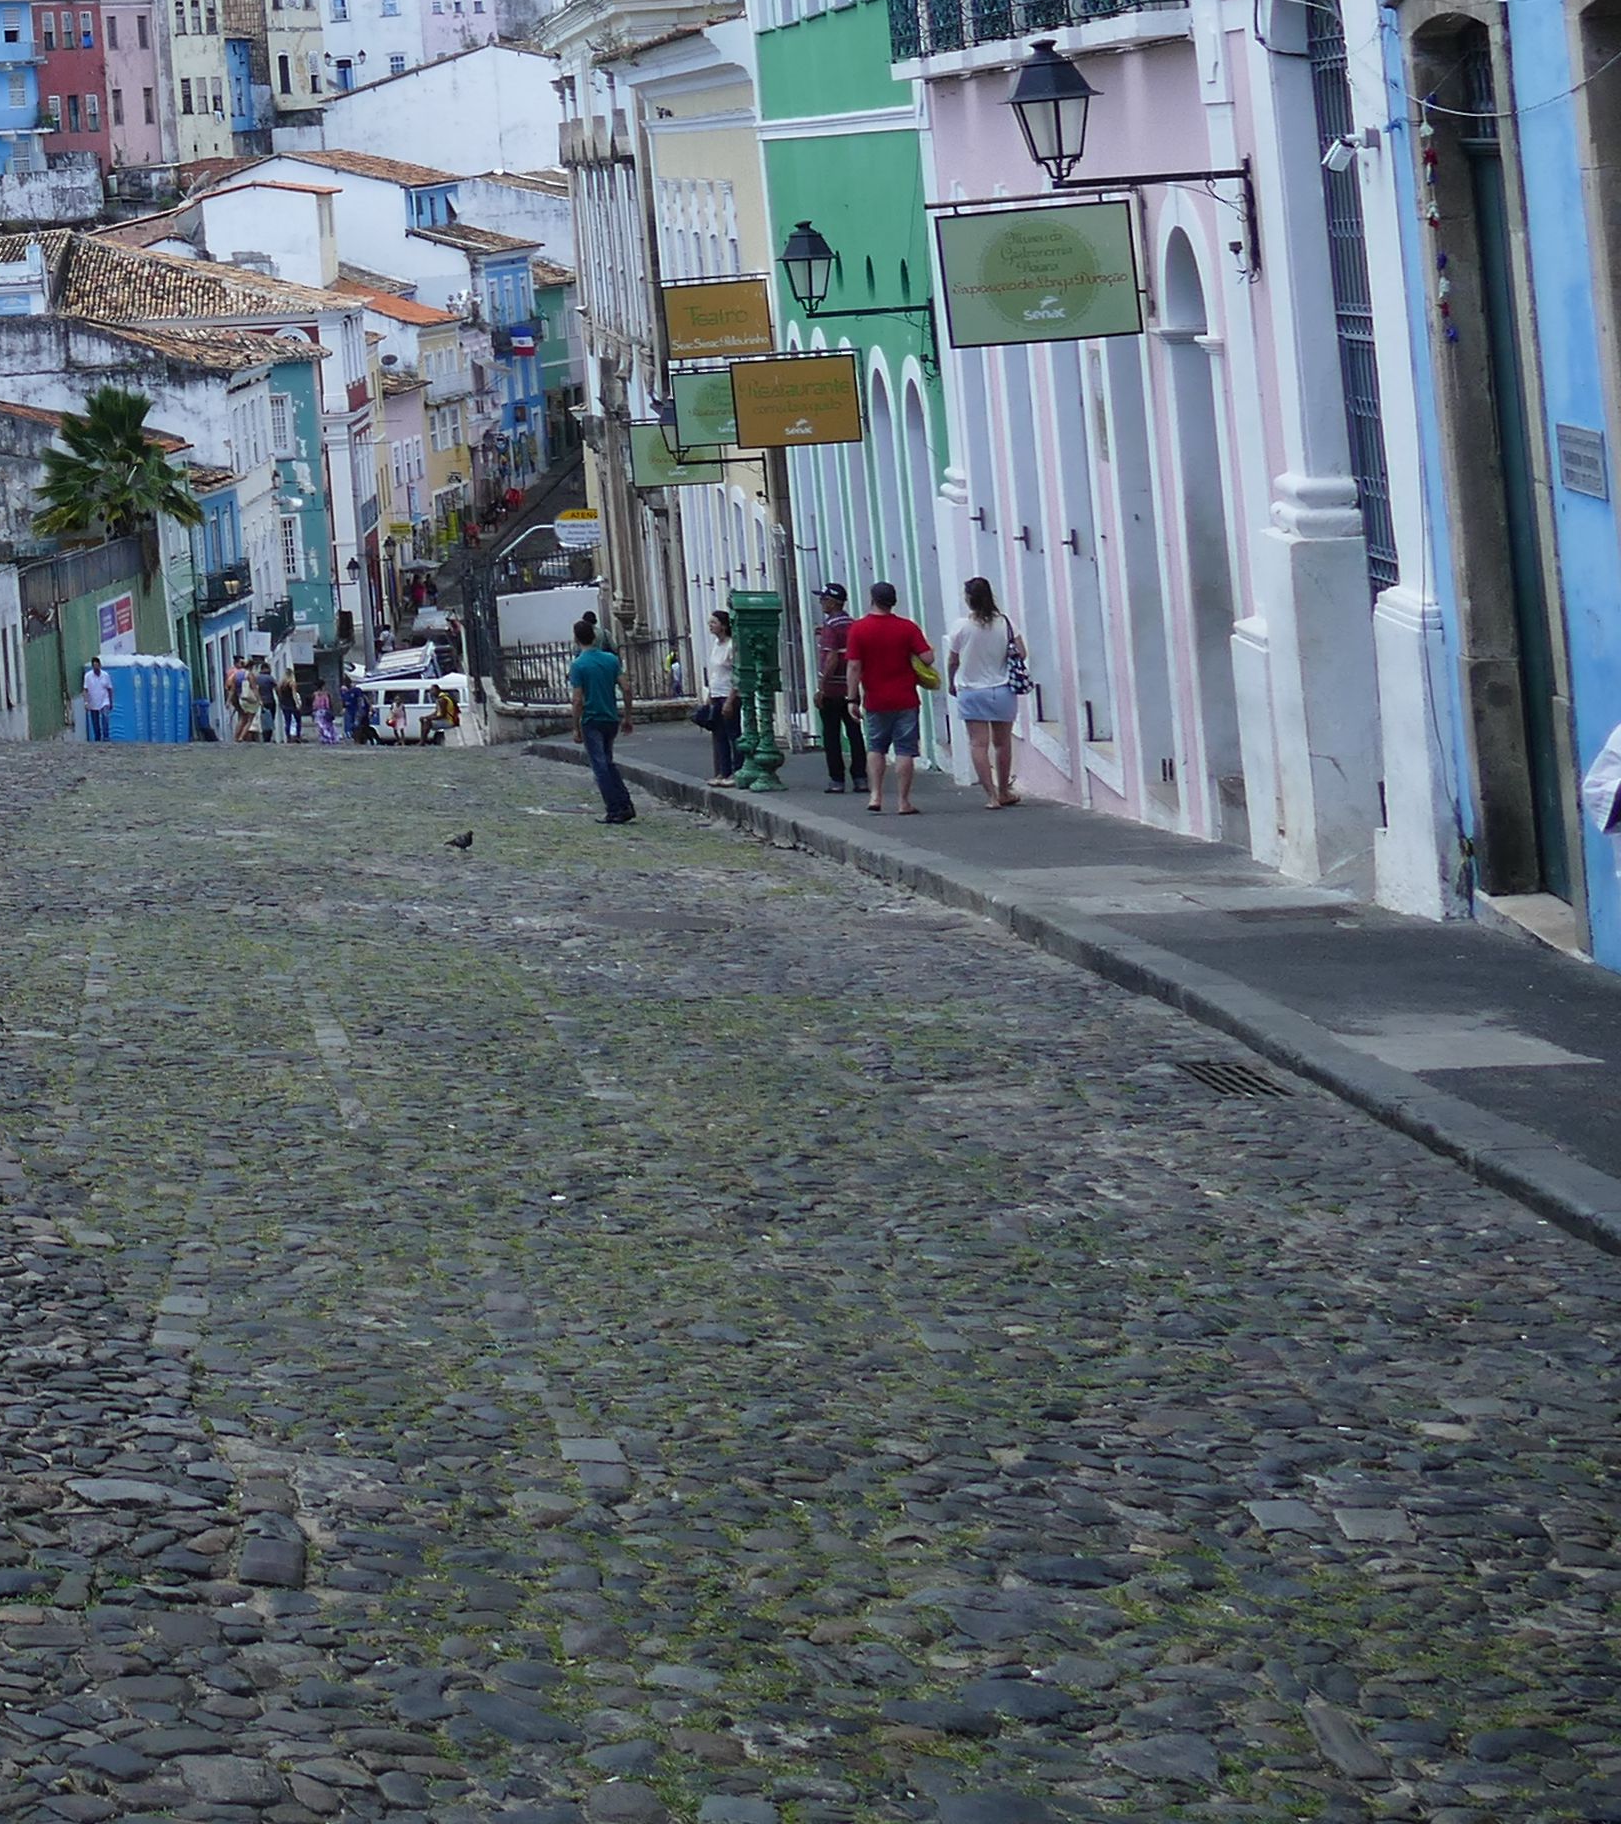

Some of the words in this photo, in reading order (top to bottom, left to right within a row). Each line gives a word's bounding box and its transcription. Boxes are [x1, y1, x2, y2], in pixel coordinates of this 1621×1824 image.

[683, 306, 748, 326] Teatro
[1023, 307, 1066, 321] senac
[744, 379, 850, 398] Restaurante
